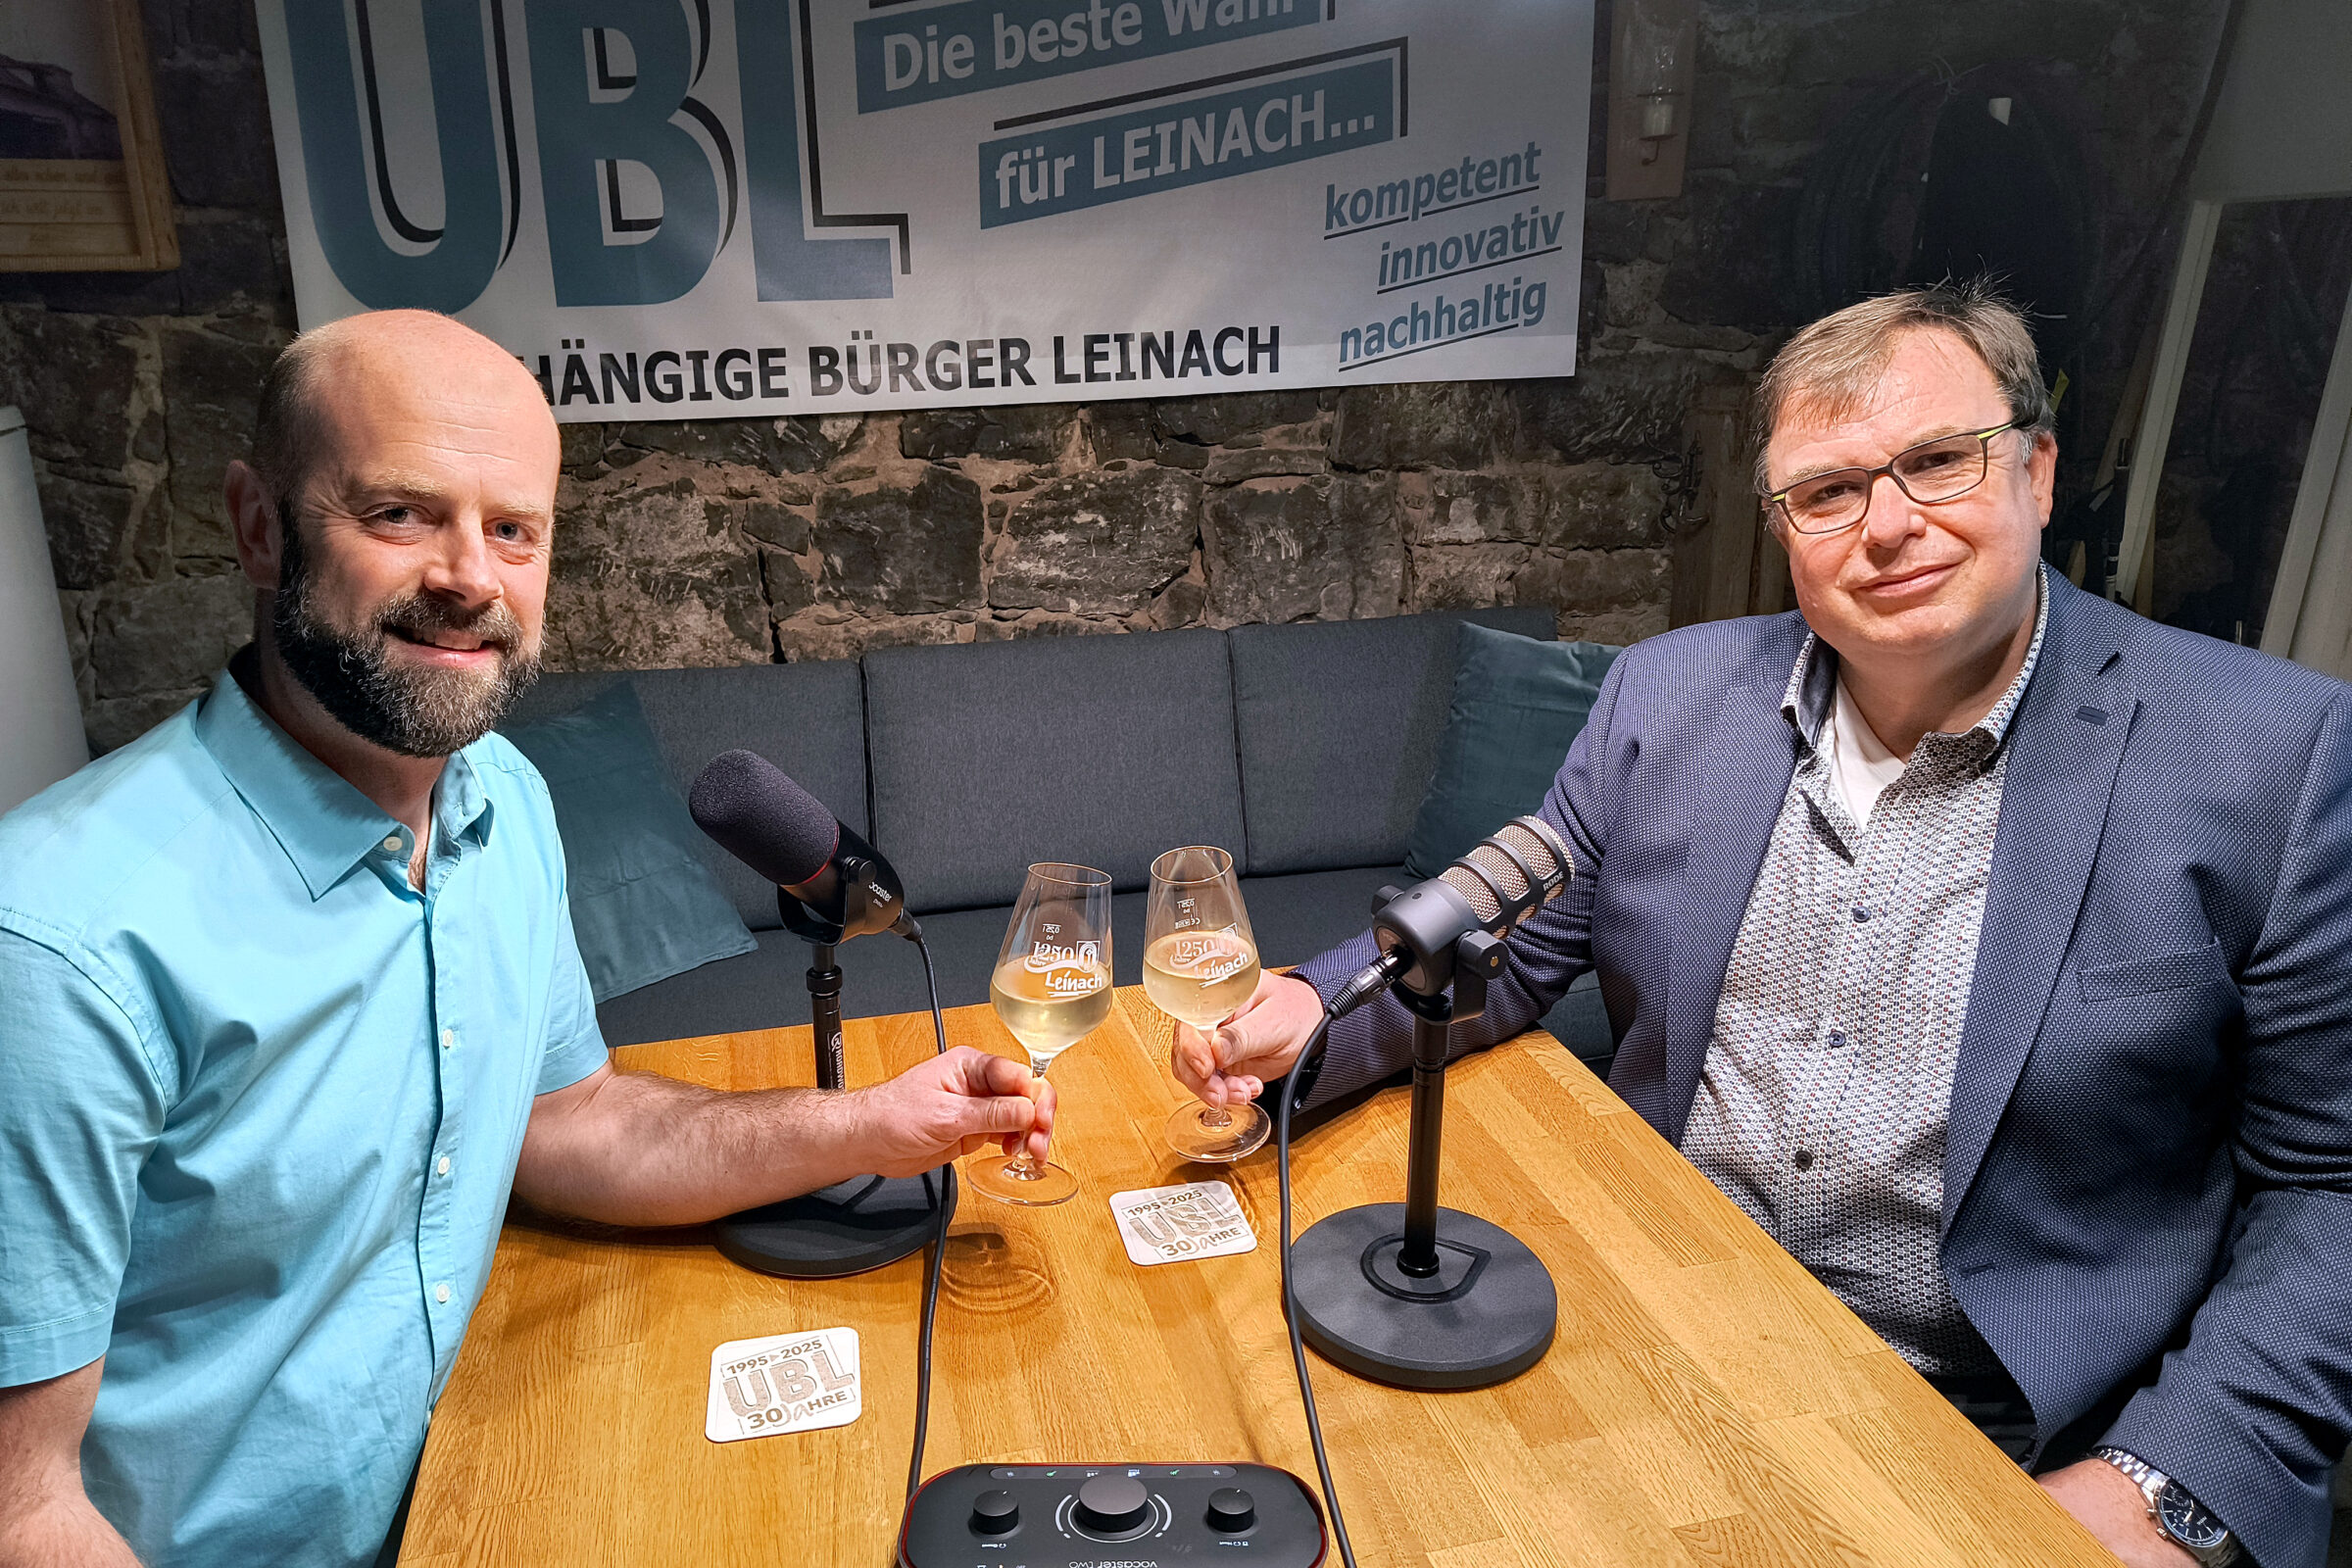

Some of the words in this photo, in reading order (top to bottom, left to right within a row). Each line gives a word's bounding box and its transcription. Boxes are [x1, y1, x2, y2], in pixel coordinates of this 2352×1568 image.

[883, 24, 975, 92] Die
[995, 1, 1143, 71] beste
[1160, 0, 1293, 36] Wa
[285, 0, 911, 313] UBL
[996, 146, 1074, 208] für
[1094, 89, 1374, 189] LEINACH...
[1325, 141, 1542, 230] kompetent
[1378, 205, 1565, 286] innovativ
[1340, 276, 1546, 364] nachhaltig
[516, 339, 789, 406] HÄNGIGE
[808, 330, 1037, 396] BÜRGER
[1054, 325, 1280, 385] LEINACH
[1176, 940, 1215, 957] 1250
[1195, 952, 1249, 980] Leinach
[1045, 970, 1102, 991] Leinach
[1127, 1201, 1161, 1216] 1995
[1168, 1190, 1202, 1205] 2025
[1129, 1198, 1243, 1248] UBL
[1162, 1240, 1193, 1256] 30
[722, 1349, 855, 1417] UBL
[727, 1355, 768, 1374] 1995
[780, 1340, 822, 1358] 2025
[748, 1407, 783, 1429] 30
